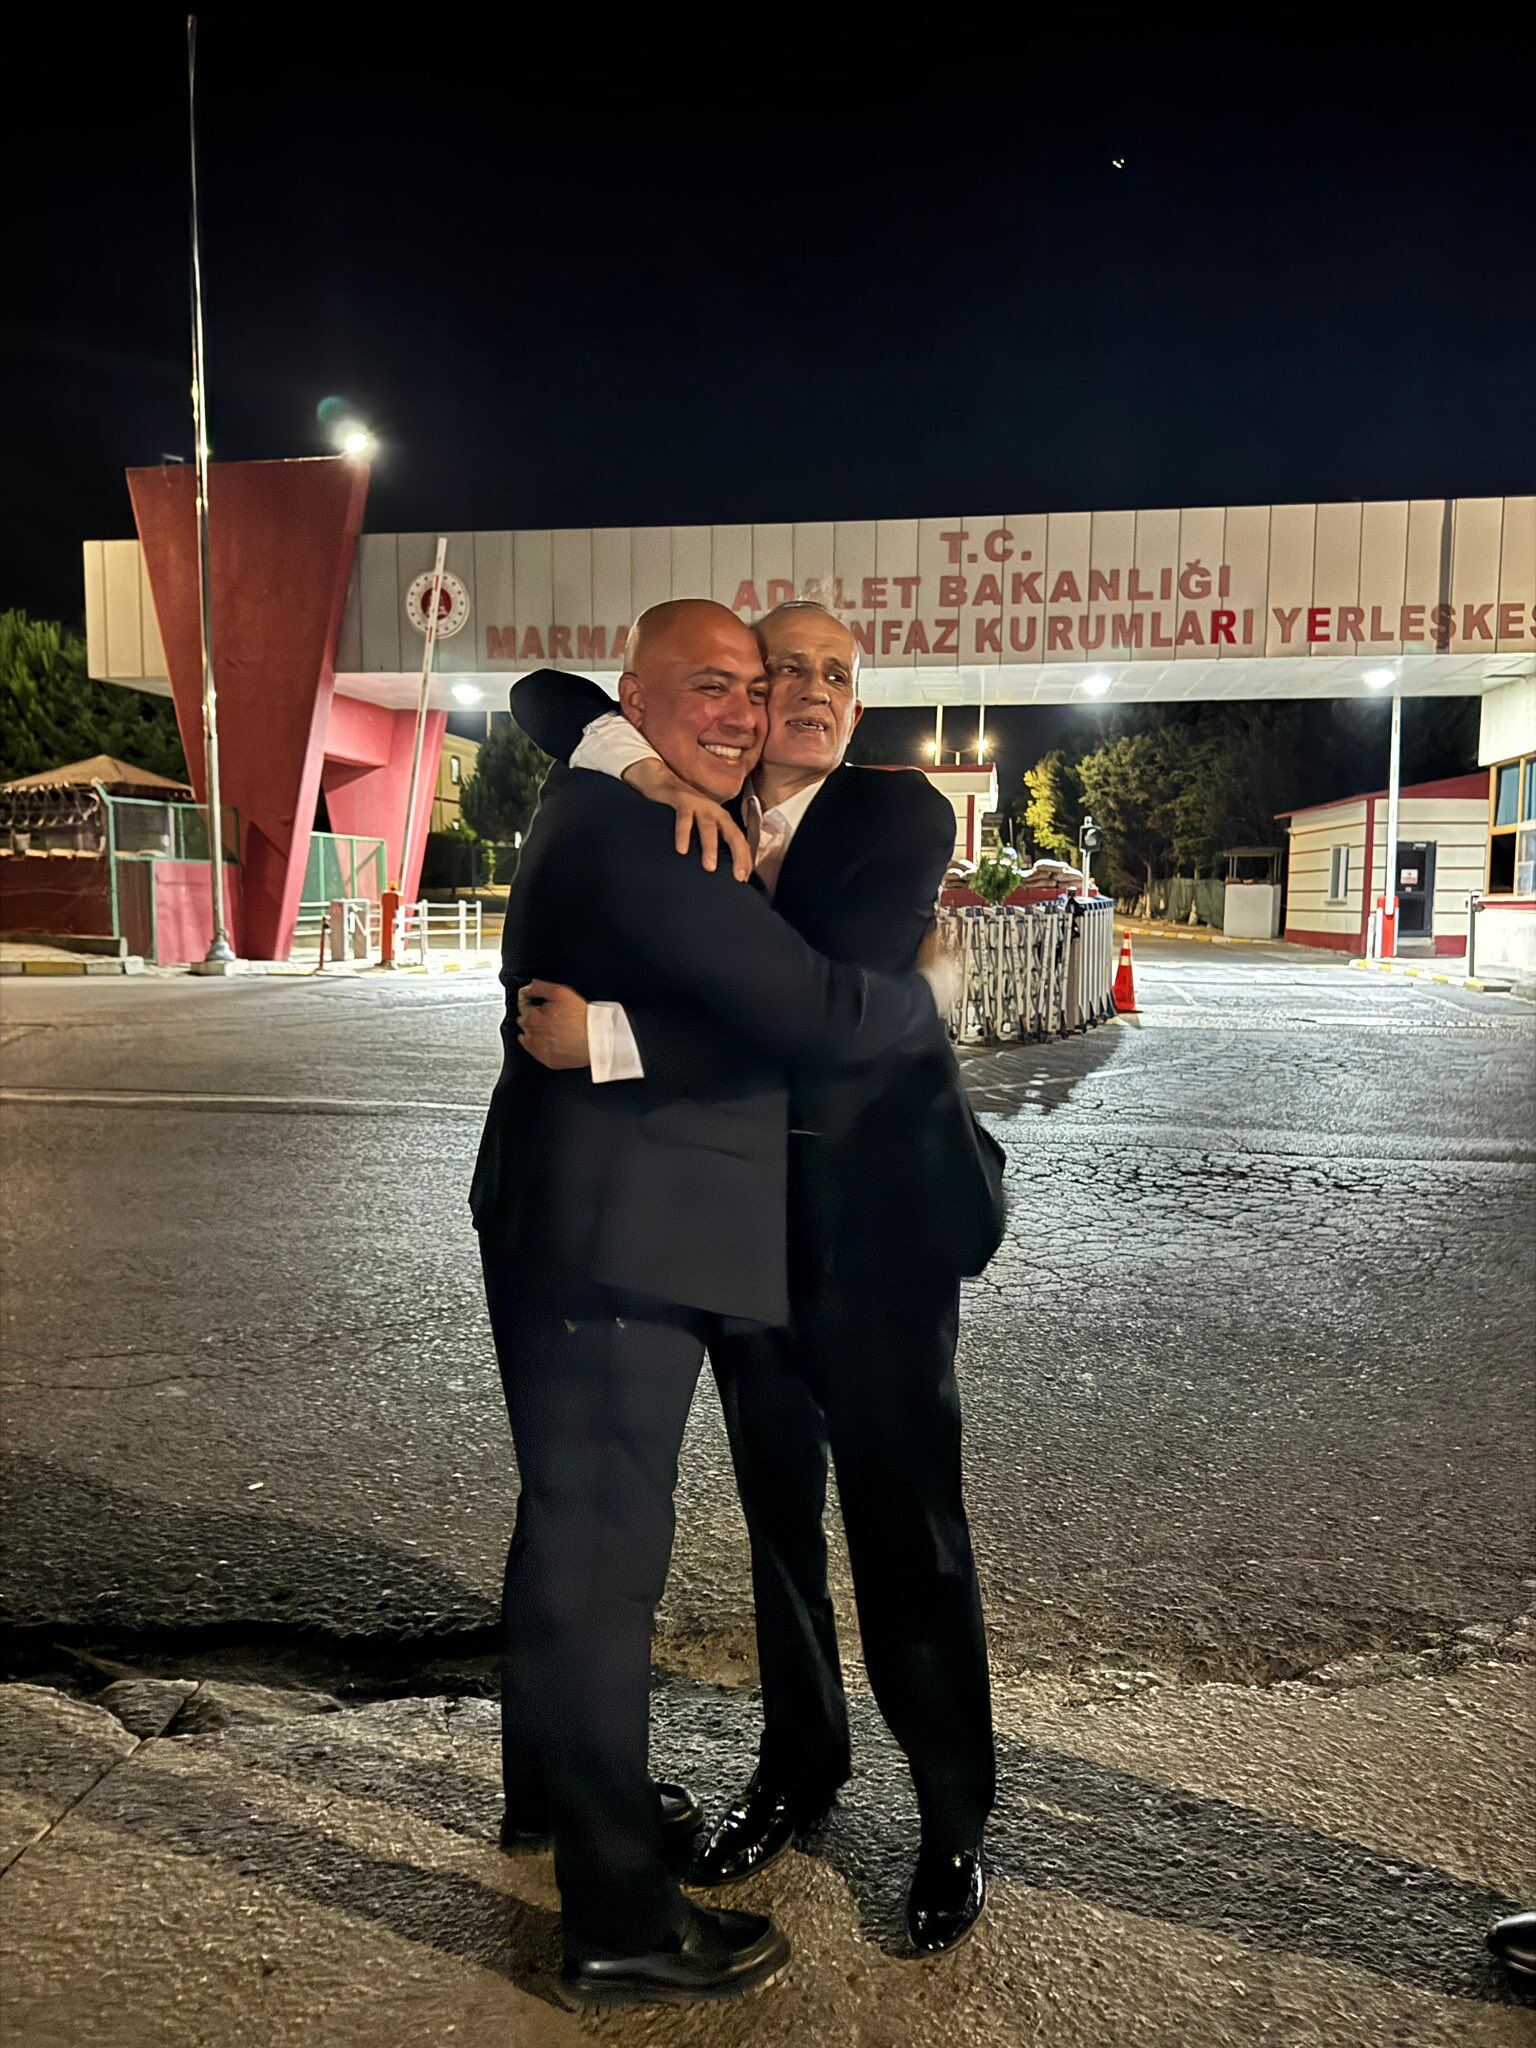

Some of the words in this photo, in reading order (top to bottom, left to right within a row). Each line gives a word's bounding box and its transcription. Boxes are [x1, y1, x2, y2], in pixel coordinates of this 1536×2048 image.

[939, 529, 1032, 564] T.C.
[938, 559, 1231, 607] BAKANLIĞI
[974, 609, 1254, 654] KURUMLARI
[1271, 602, 1536, 649] YERLEŞKE
